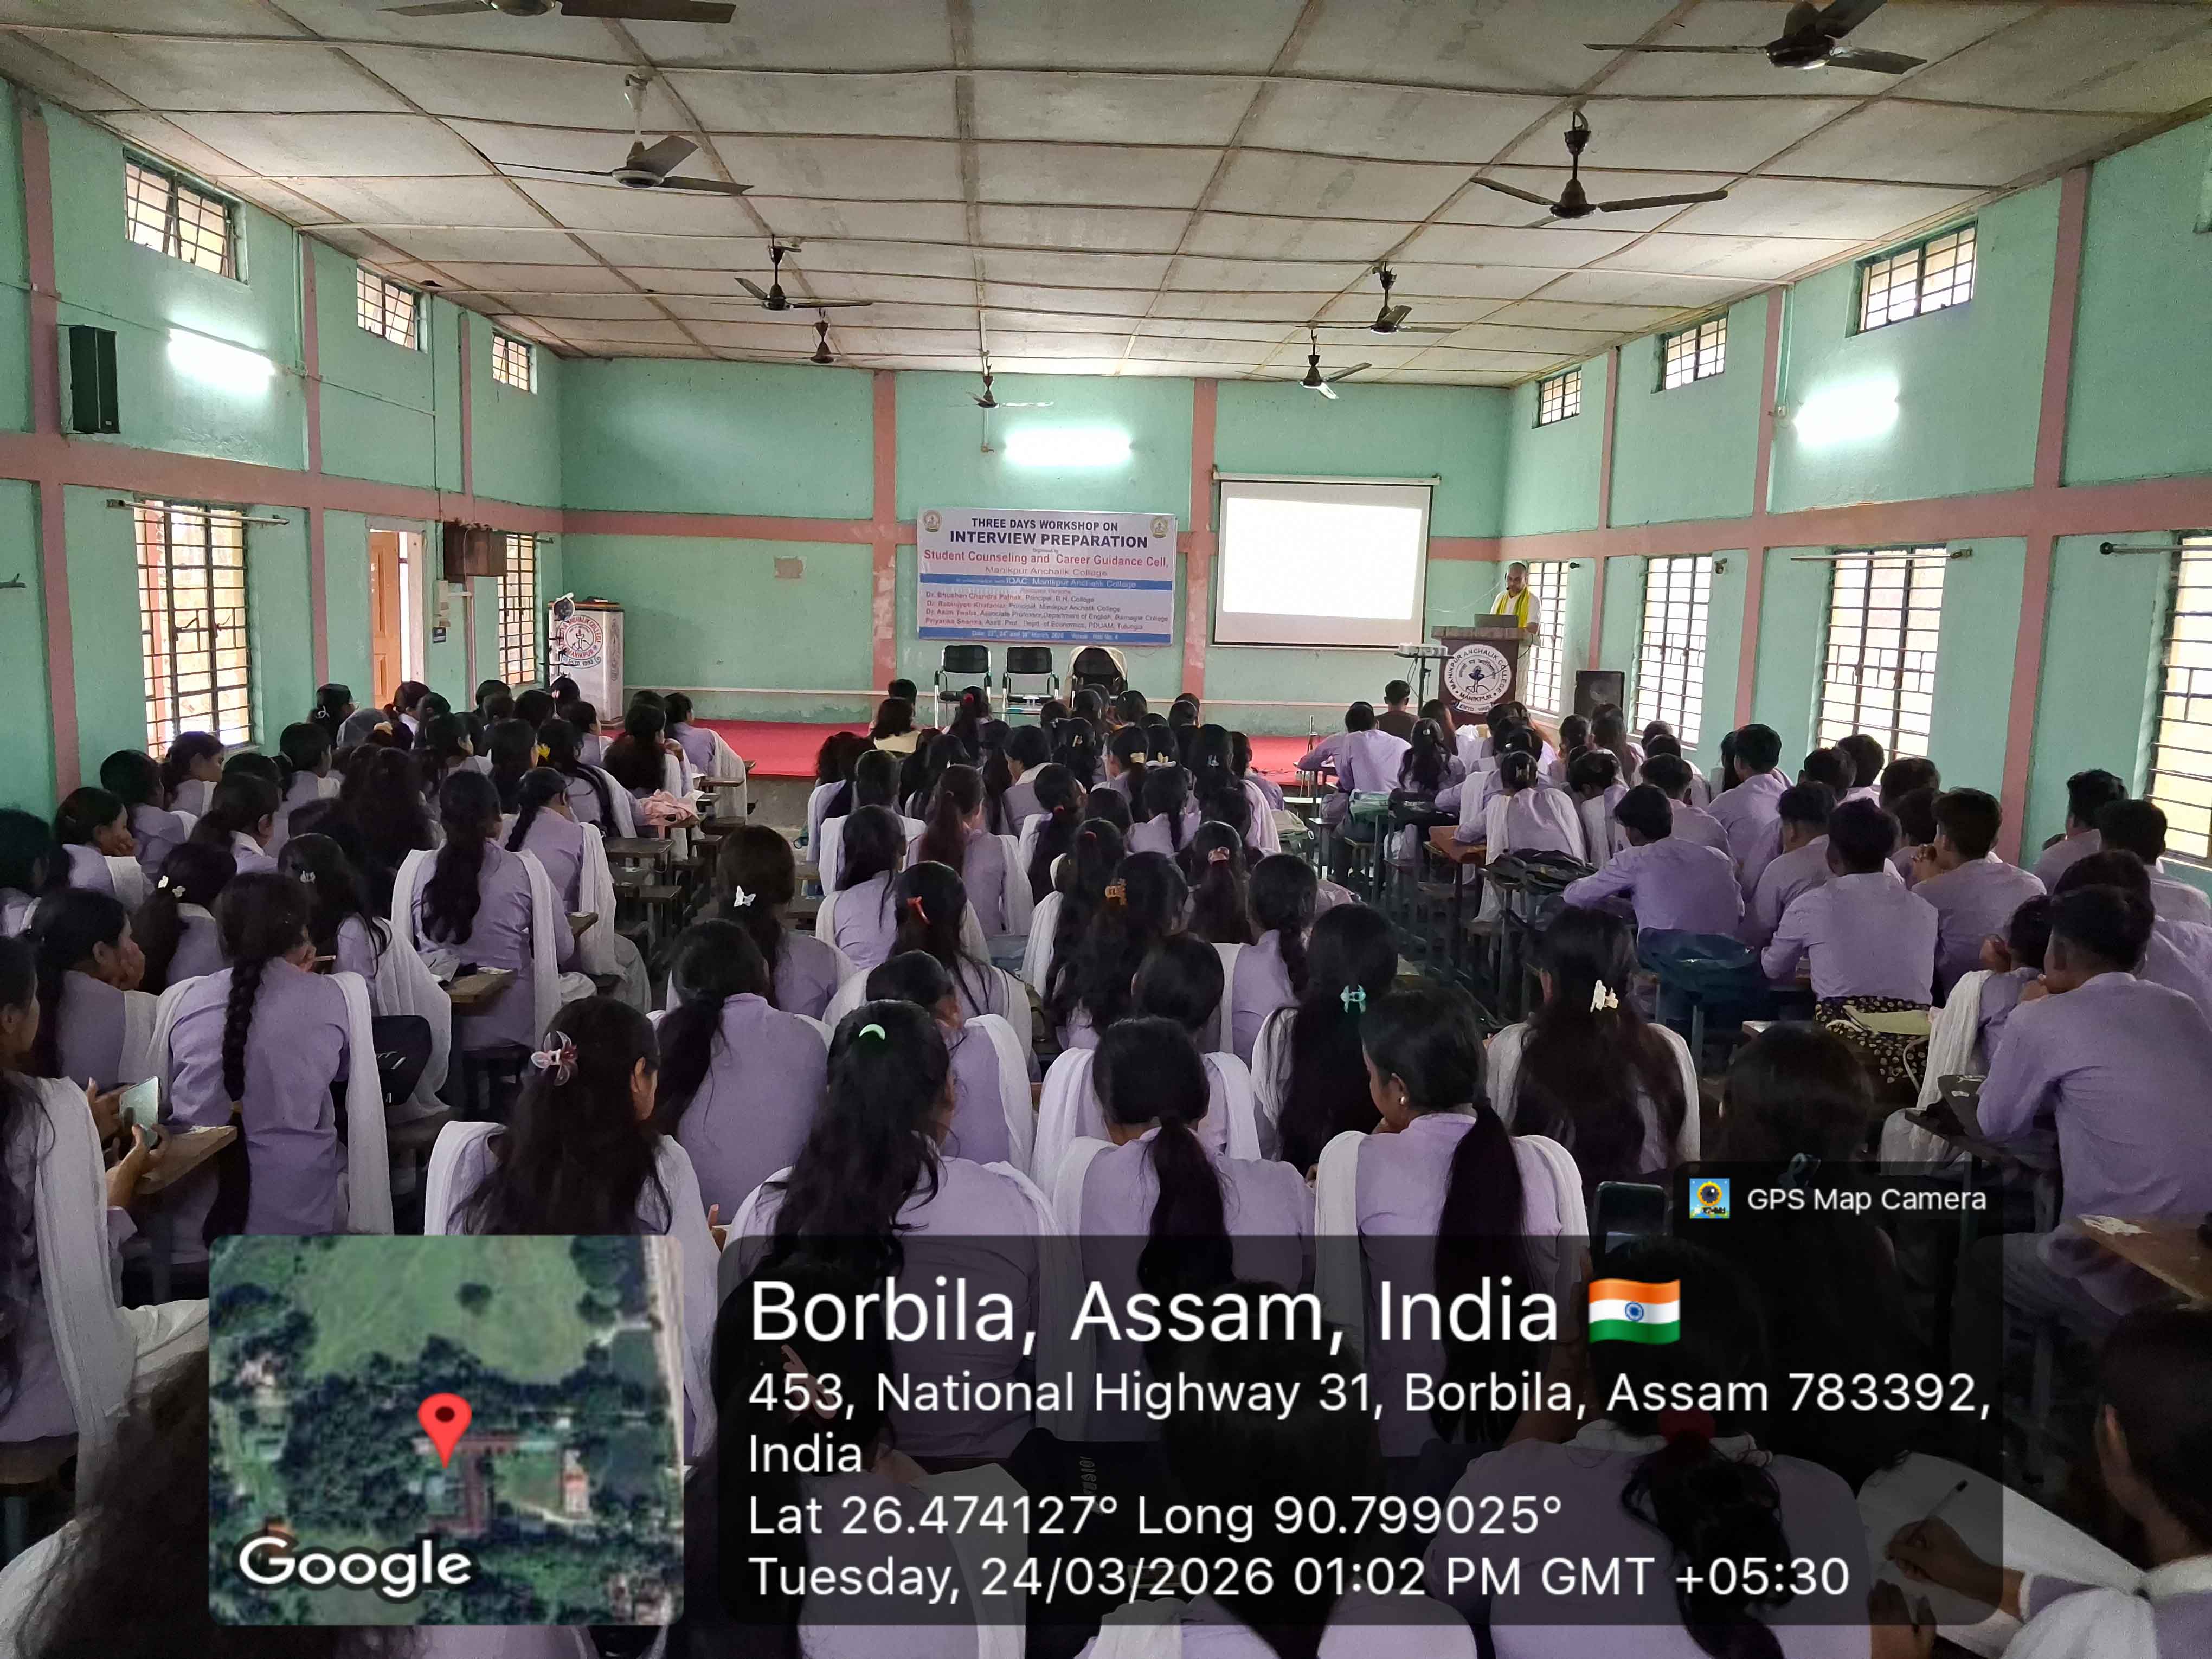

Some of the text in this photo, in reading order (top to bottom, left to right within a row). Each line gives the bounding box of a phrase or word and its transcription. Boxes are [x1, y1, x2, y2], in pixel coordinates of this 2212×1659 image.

[972, 518, 1118, 532] THREE DAYS WORKSHOP ON
[950, 530, 1147, 548] INTERVIEW PREPARATION
[924, 549, 1169, 568] Student Counseling and Career Guidance Cell,
[985, 566, 1108, 577] Manikpur Anchalik College
[1032, 577, 1069, 587] Manikpur
[1106, 581, 1137, 589] College
[1448, 654, 1462, 690] MANIKPUR
[1463, 648, 1499, 660] ANCHALIK
[1496, 660, 1507, 694] COLLEGE
[1459, 692, 1493, 702] MANIKPUR
